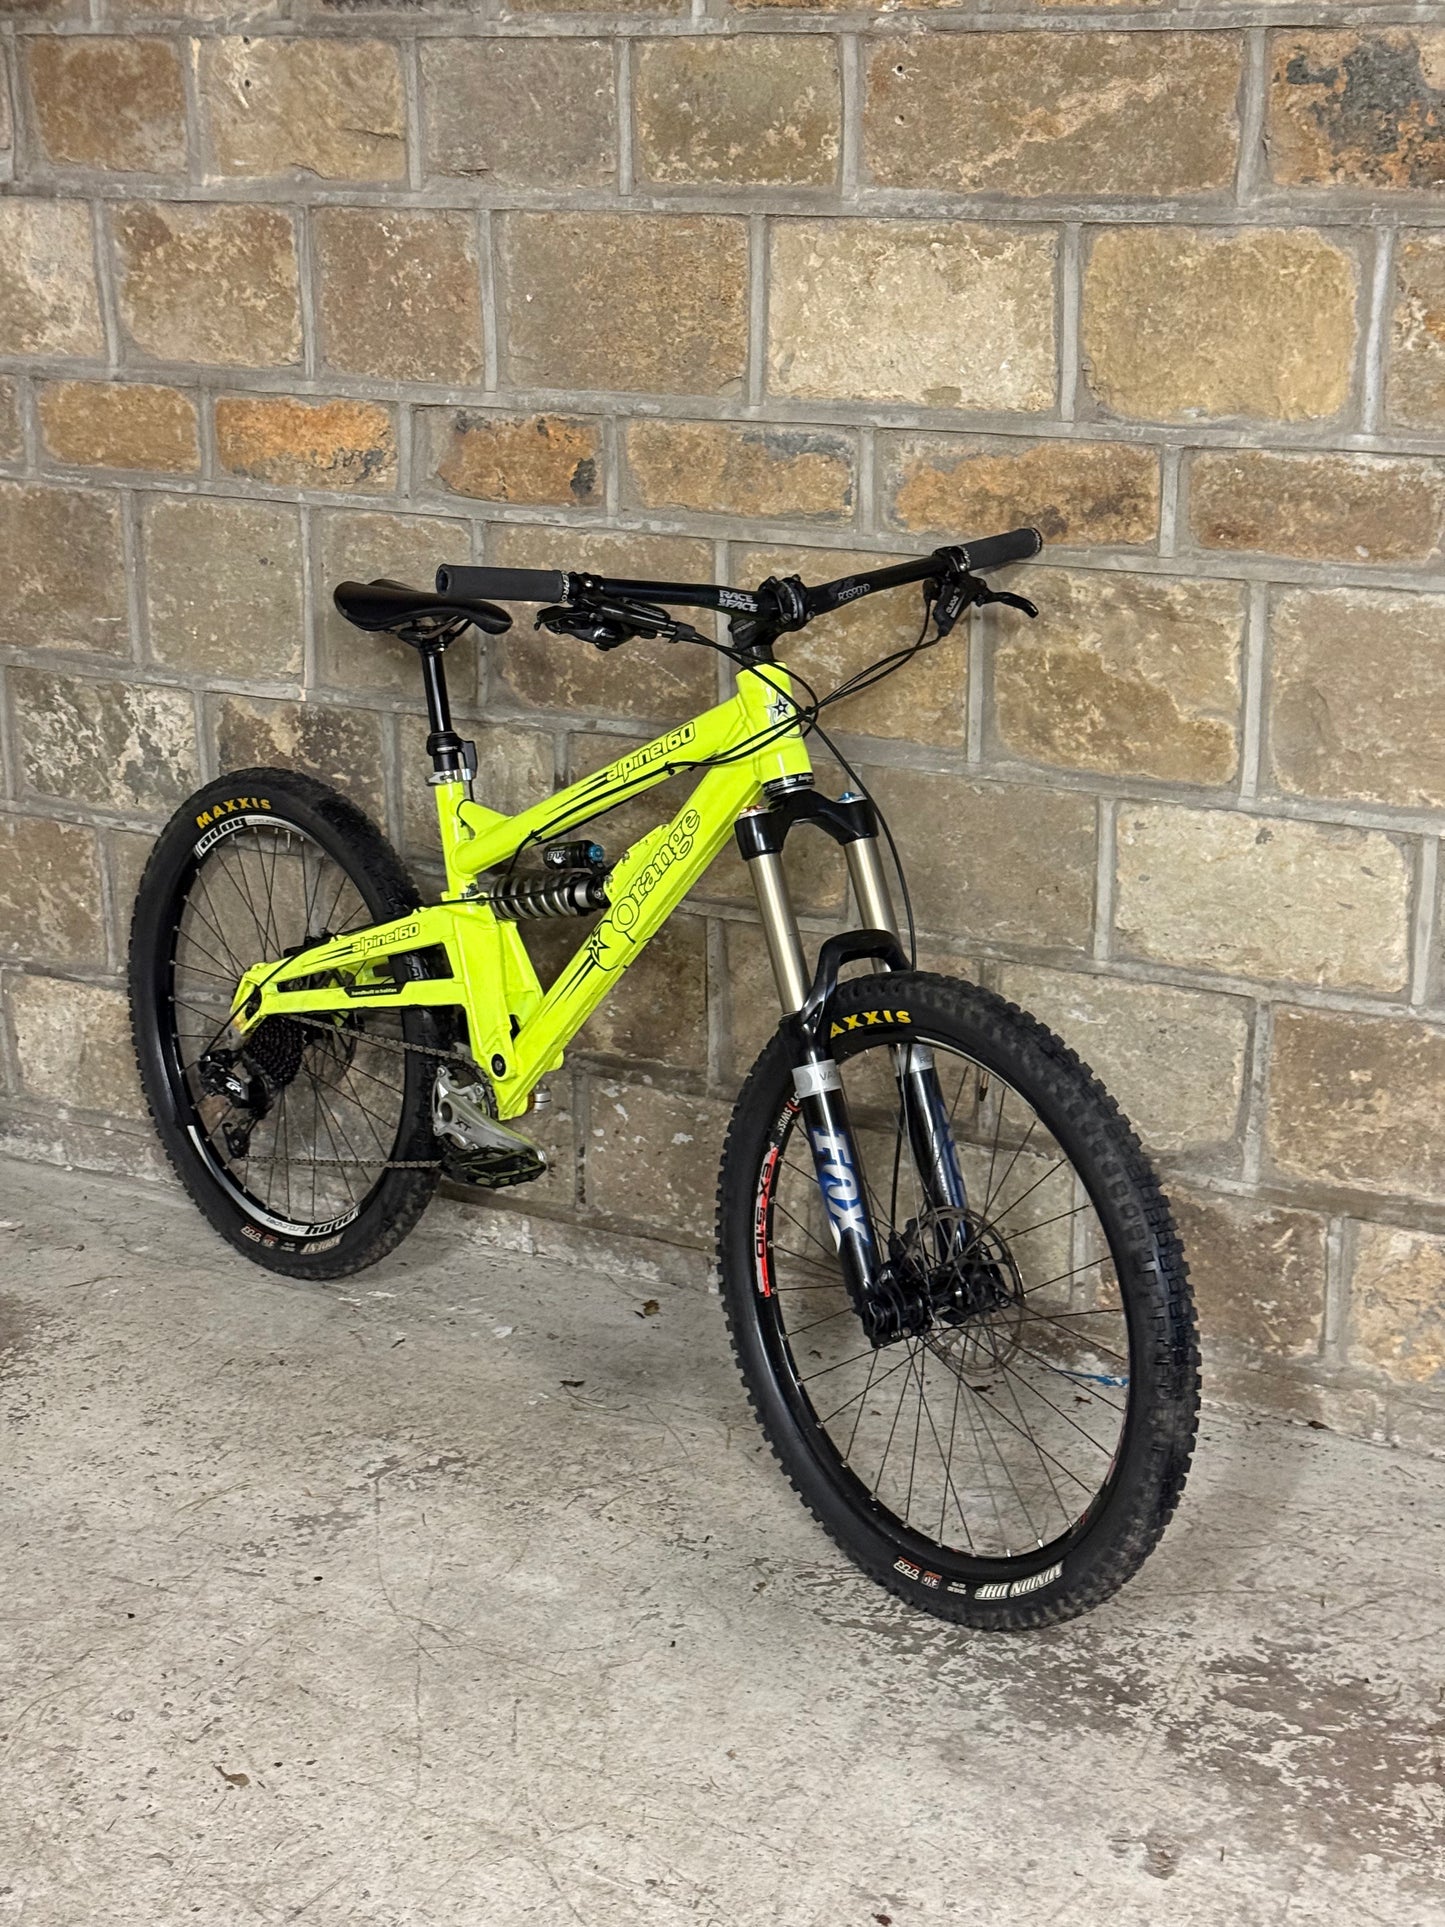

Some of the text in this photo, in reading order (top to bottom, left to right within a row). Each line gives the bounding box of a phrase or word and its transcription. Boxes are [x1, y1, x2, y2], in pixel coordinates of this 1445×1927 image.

[719, 590, 754, 602] RACE
[725, 599, 758, 612] FACE
[605, 721, 696, 783] alpine160
[196, 797, 272, 829] MAXXIS
[611, 809, 700, 933] Orange
[351, 922, 420, 957] alpine160
[830, 1010, 911, 1038] AXXIS
[454, 1118, 472, 1132] XT
[777, 1106, 793, 1133] SWISS
[813, 1129, 870, 1243] FOX
[975, 1582, 1011, 1600] DHF
[1010, 1560, 1064, 1597] MINION
